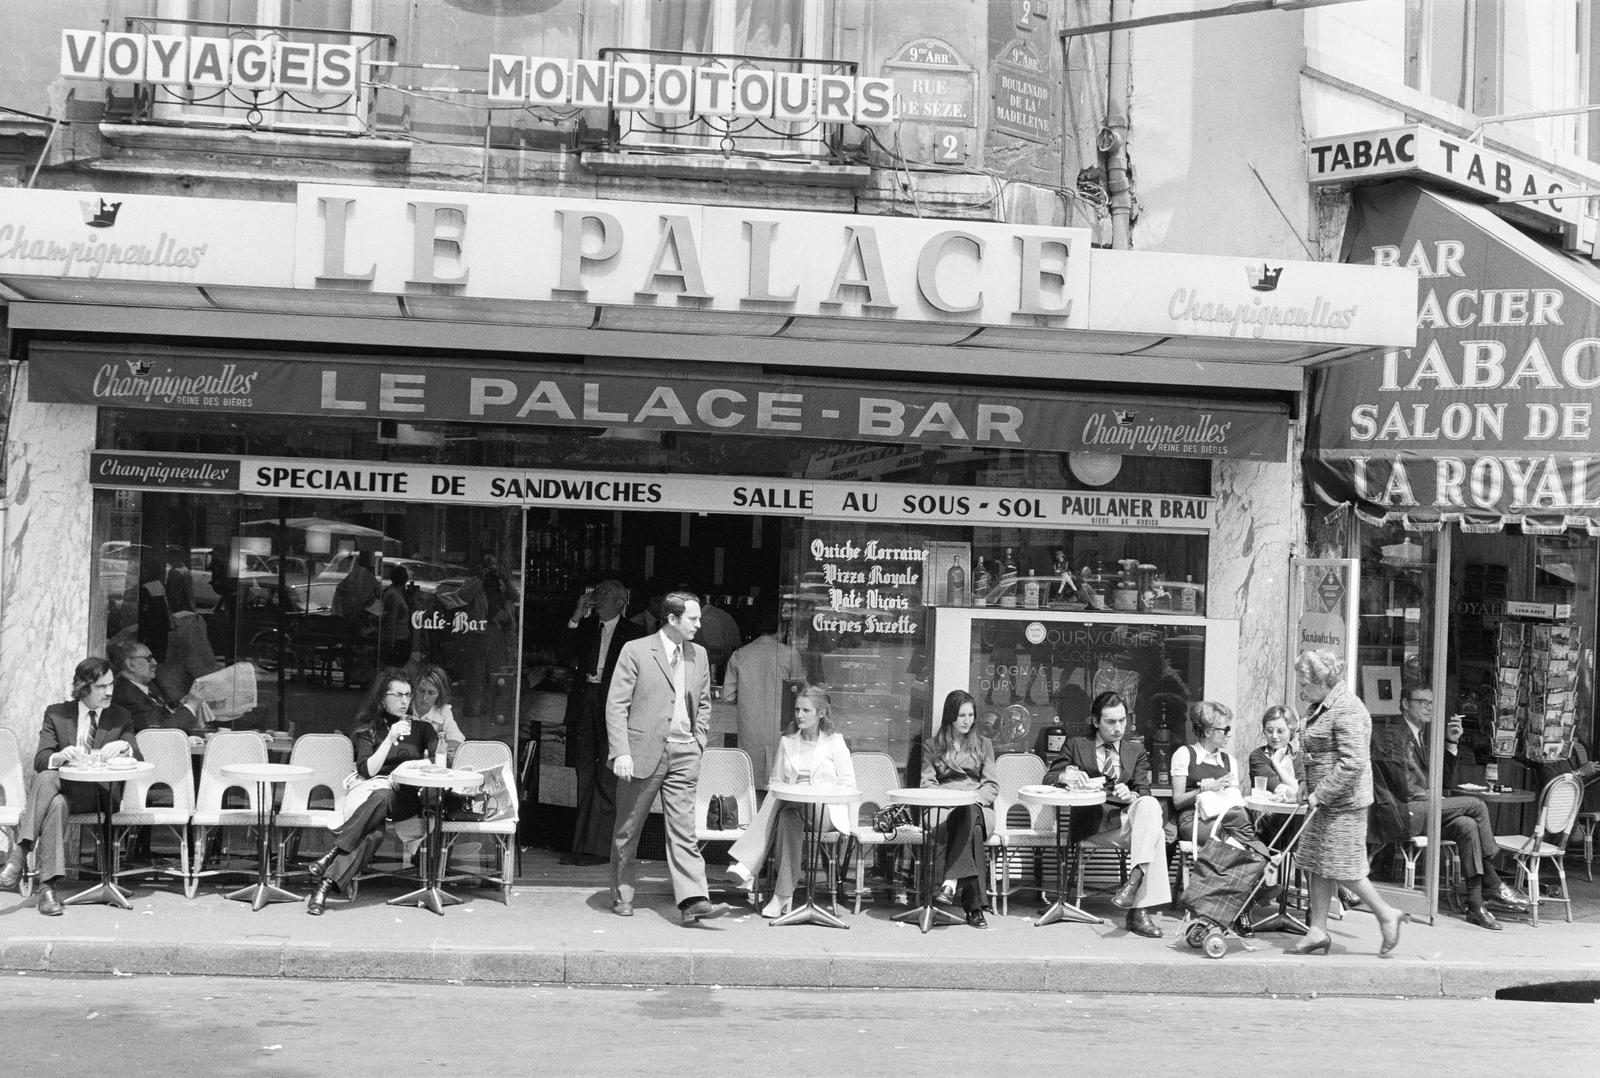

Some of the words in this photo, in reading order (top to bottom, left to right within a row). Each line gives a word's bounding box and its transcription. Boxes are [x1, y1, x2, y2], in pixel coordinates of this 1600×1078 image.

[1021, 0, 1030, 24] 2
[65, 34, 352, 87] VOYAGES
[491, 58, 890, 119] MONDOTOURS
[912, 79, 948, 95] RUE
[1002, 76, 1048, 100] BOULEVARD
[997, 106, 1049, 131] MADELEINE
[1010, 94, 1022, 109] DE
[1025, 98, 1036, 112] LA
[942, 134, 959, 159] 2
[1311, 134, 1415, 173] TABAC
[1439, 139, 1564, 214] TABAC
[315, 196, 470, 286] LE
[551, 209, 1074, 319] PALACE
[1371, 239, 1466, 278] BAR
[1168, 287, 1358, 339] Champigneulles
[1416, 288, 1565, 329] ACIER
[1378, 336, 1600, 392] TABAC
[93, 364, 259, 404] Champigneulles
[176, 396, 200, 406] REINE
[203, 397, 220, 407] DES
[321, 370, 427, 413] LE
[469, 377, 804, 431] PALACE
[859, 398, 1024, 443] BAR
[1082, 413, 1232, 451] Champigneulles
[1350, 401, 1508, 441] SALON
[1523, 402, 1592, 441] DE
[1158, 443, 1181, 453] REINE
[1183, 445, 1198, 453] DES
[99, 459, 230, 483] Champigneulles
[1349, 454, 1420, 506] LA
[431, 475, 466, 496] DE
[490, 477, 663, 503] SANDWICHES
[733, 487, 814, 510] SALLE
[842, 492, 878, 513] AU
[1061, 495, 1153, 518] PAULANER
[1160, 500, 1208, 520] BRAU
[811, 538, 862, 561] Quiche
[864, 540, 930, 562] Lorraine
[823, 563, 866, 584] Pizza
[867, 564, 920, 588] Royale
[864, 614, 918, 635] Suzette
[1301, 629, 1341, 646] Sandwiches
[985, 664, 1048, 677] COGNAC
